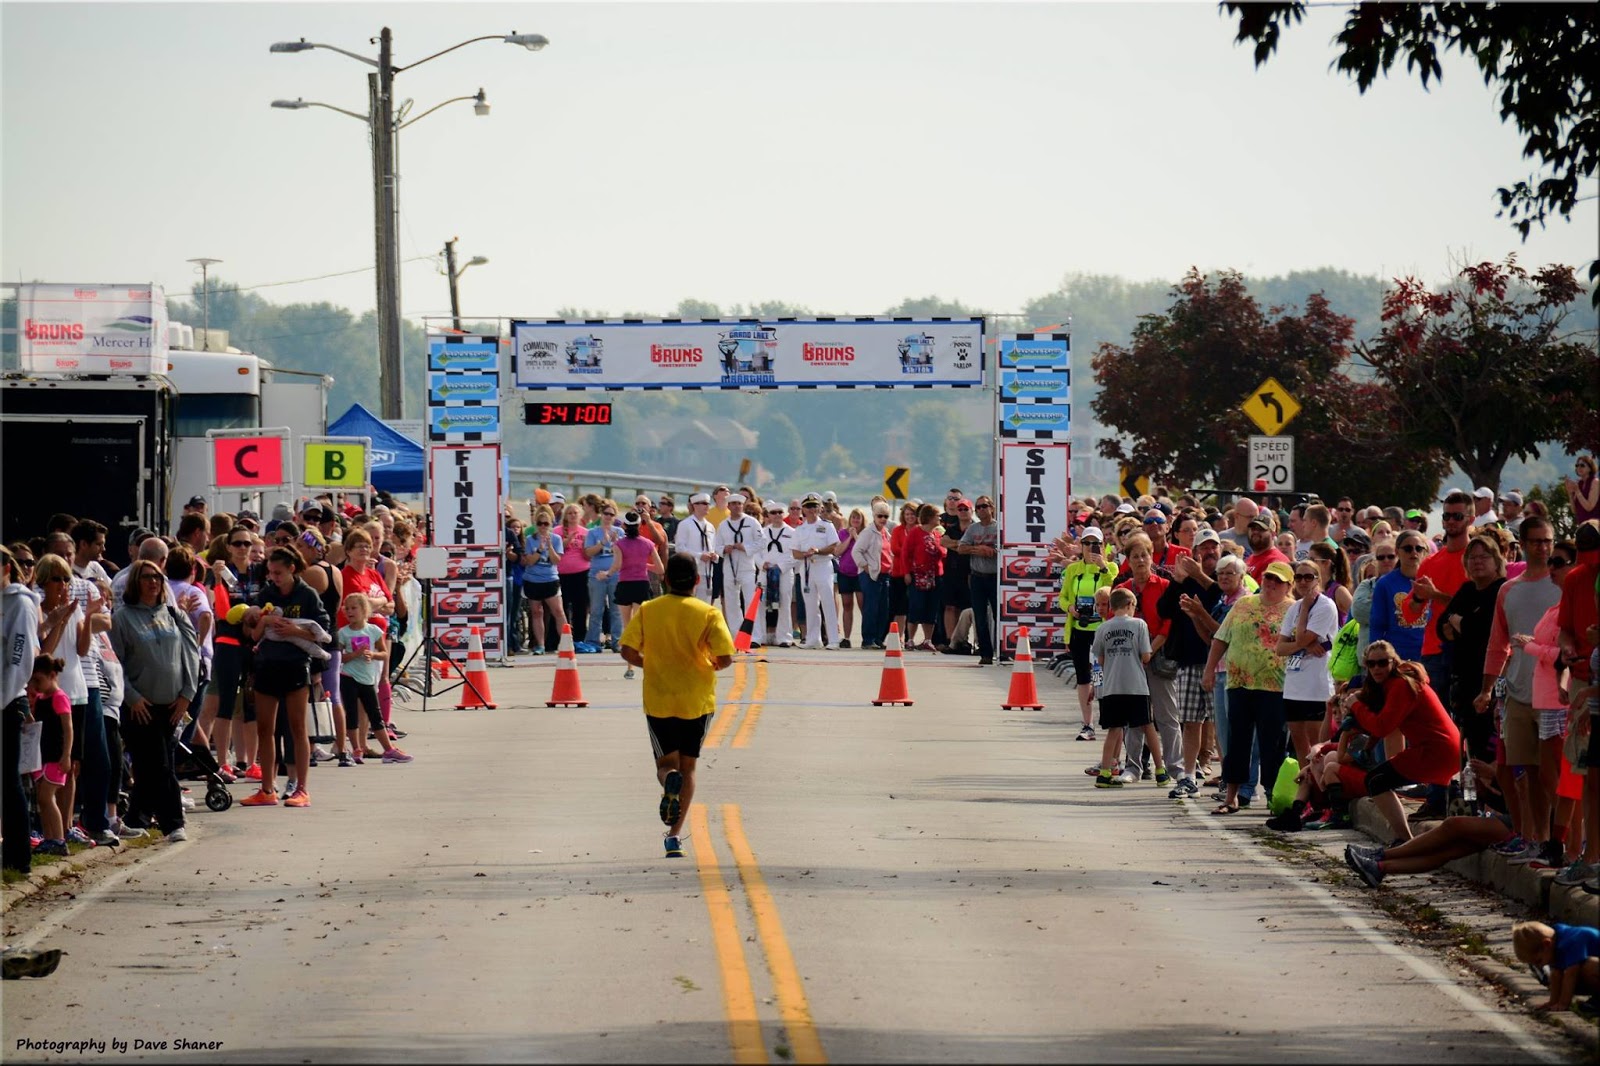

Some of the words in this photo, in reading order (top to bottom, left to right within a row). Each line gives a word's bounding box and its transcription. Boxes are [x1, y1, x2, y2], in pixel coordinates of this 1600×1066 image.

[93, 336, 133, 348] Mercer
[729, 331, 751, 339] GRAND
[753, 331, 769, 339] LAKE
[523, 341, 558, 353] COMMUNITY
[1253, 442, 1290, 451] SPEED
[234, 445, 259, 478] C
[324, 450, 347, 481] B
[1257, 453, 1286, 462] LIMIT
[1255, 464, 1288, 484] 20
[454, 450, 475, 544] FINISH
[1026, 449, 1046, 543] START
[1105, 629, 1134, 641] COMMUNITY
[11, 633, 26, 667] KRISTIN
